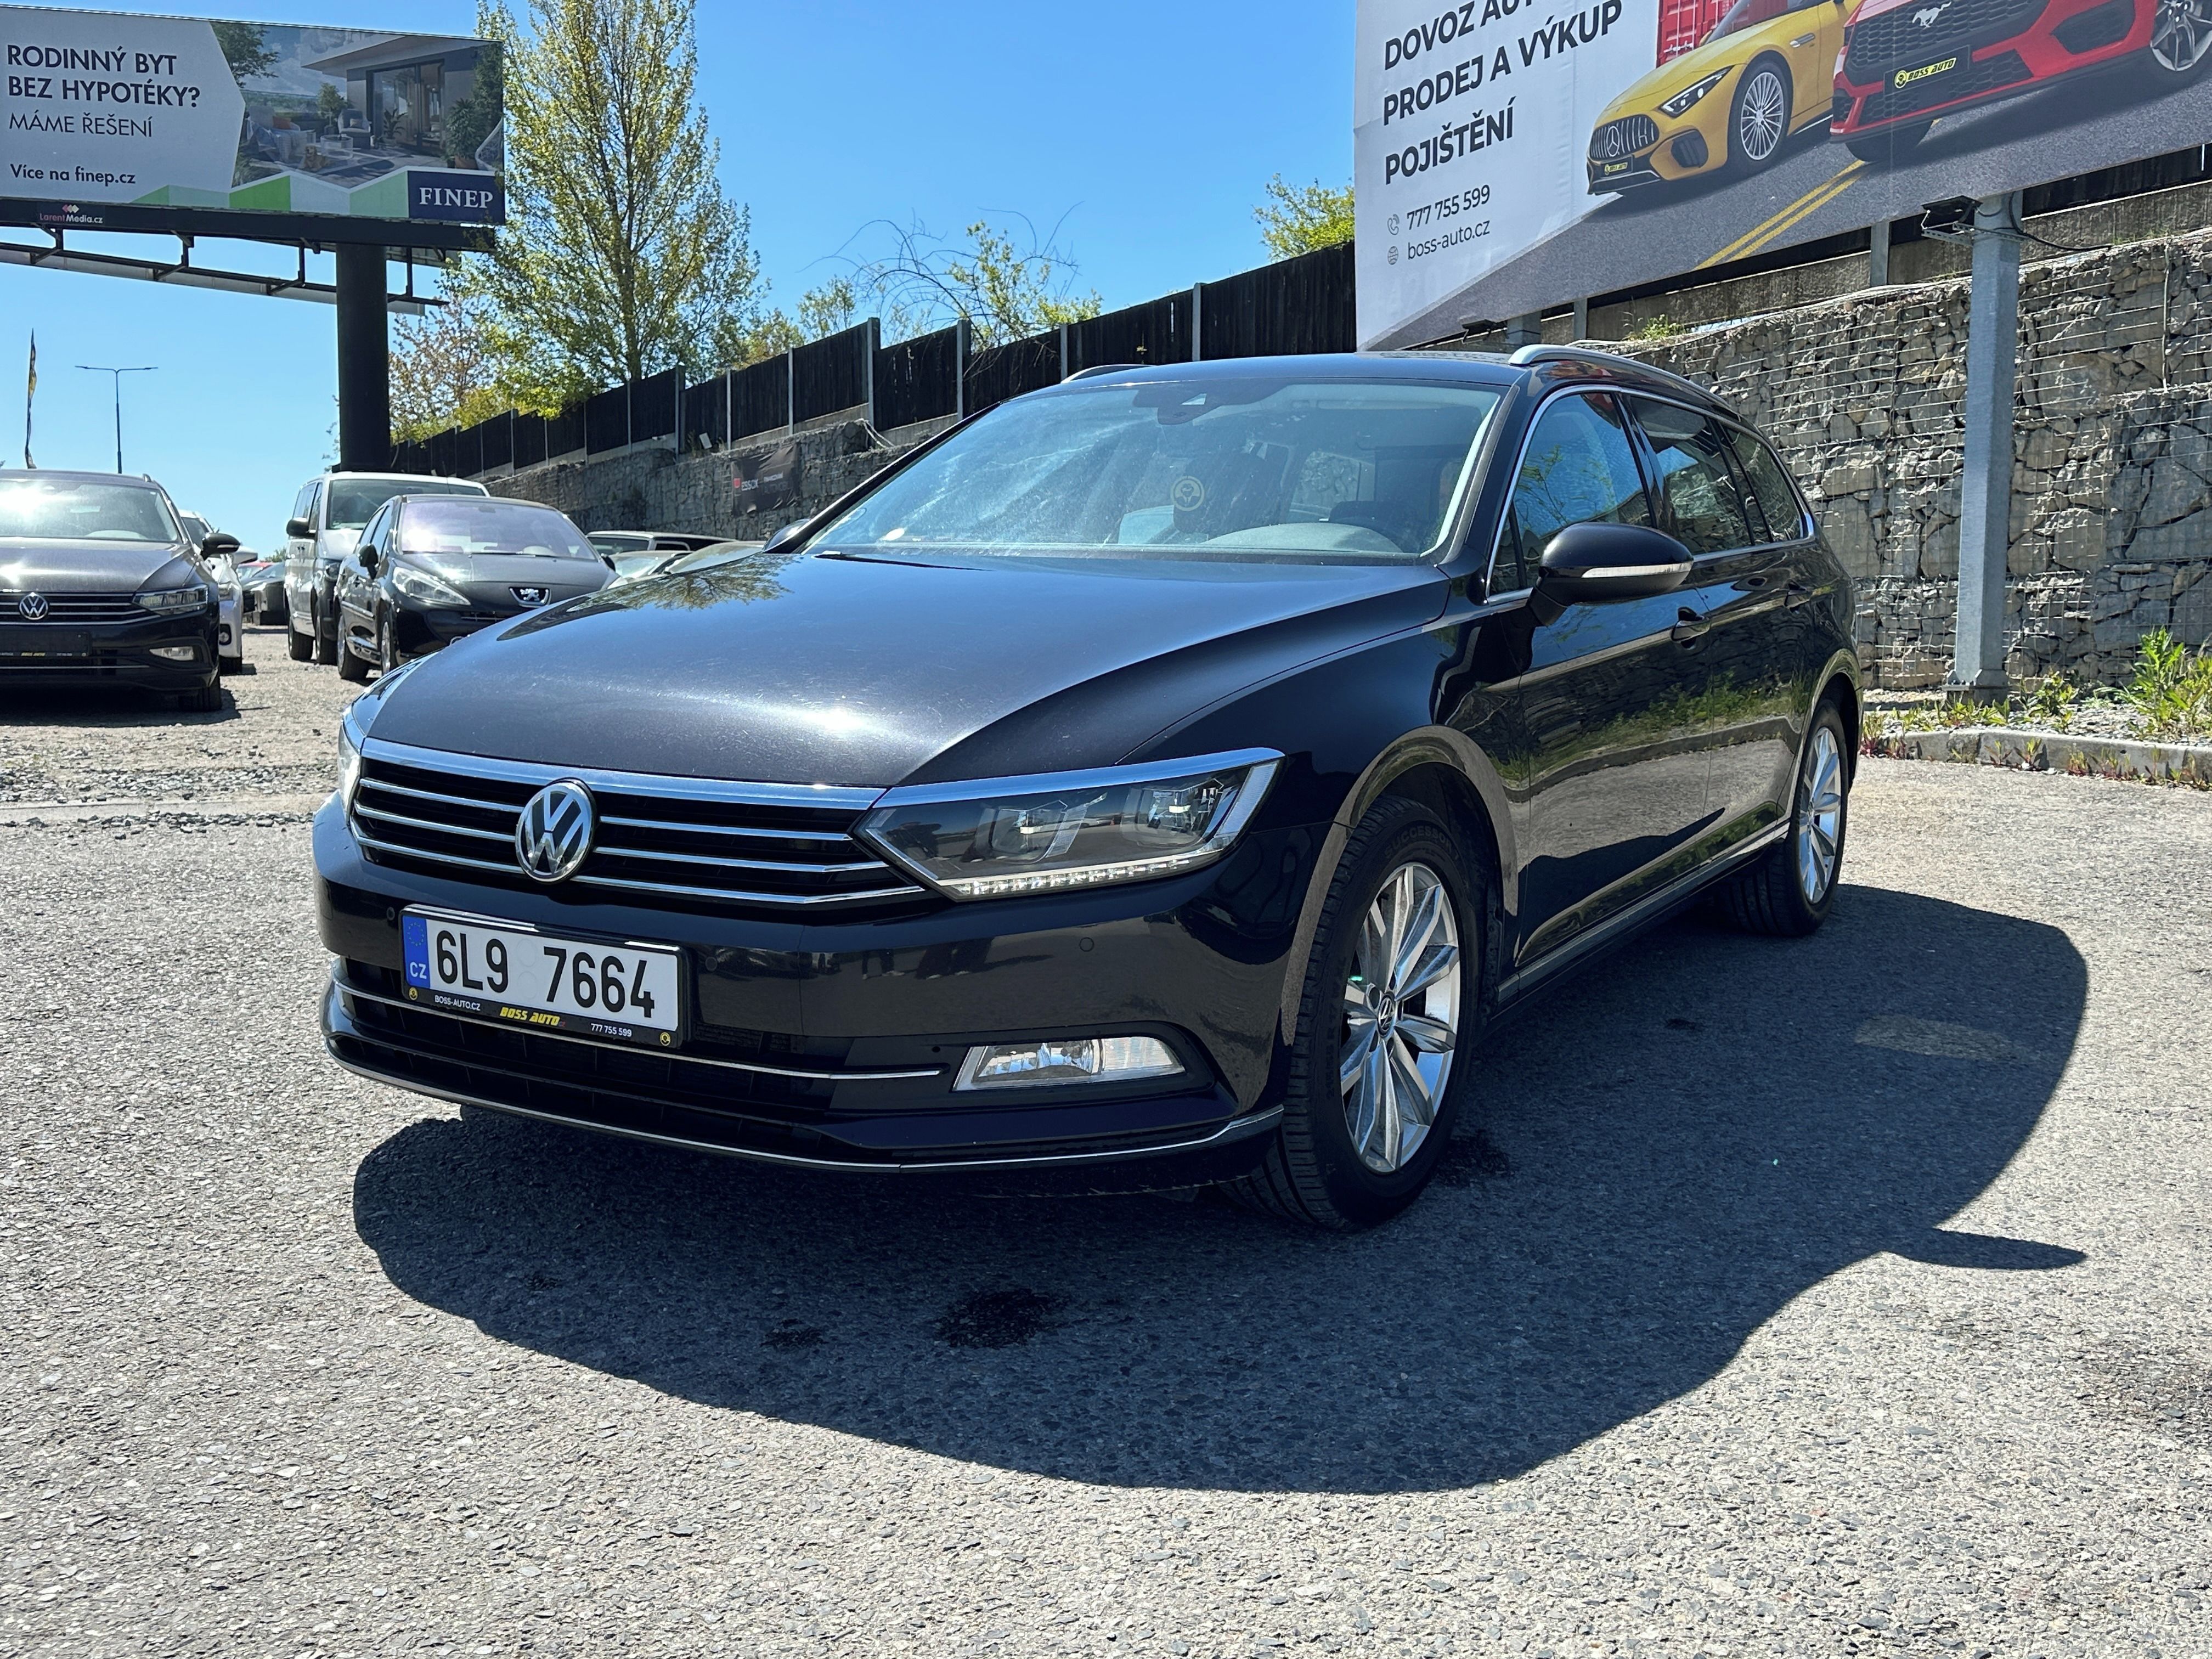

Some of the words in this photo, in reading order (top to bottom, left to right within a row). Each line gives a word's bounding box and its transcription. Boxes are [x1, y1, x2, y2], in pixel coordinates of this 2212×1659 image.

[1385, 1, 1475, 70] DOVOZ
[7, 44, 126, 72] RODINNÝ
[135, 53, 177, 75] BYT
[1384, 55, 1483, 126] PRODEJ
[1489, 46, 1511, 82] A
[1517, 0, 1622, 67] VÝKUP
[1908, 67, 1929, 80] BOSS
[1931, 59, 1954, 74] AUTO
[8, 76, 52, 99] BEZ
[62, 79, 200, 108] HYPOTÉKY?
[9, 110, 75, 133] MÁME
[82, 112, 153, 137] ŘEŠENÍ
[1385, 95, 1516, 185] POJIŠTĚNÍ
[10, 164, 44, 180] Více
[49, 168, 70, 181] na
[75, 166, 136, 187] finep.cz
[419, 187, 493, 210] FINEP
[1407, 205, 1431, 230] 777
[1435, 195, 1459, 221] 755
[1463, 184, 1490, 211] 599
[1408, 220, 1491, 260] boss-auto.cz
[410, 962, 427, 979] CZ
[436, 930, 509, 994] 6L9
[544, 946, 656, 1019] 7664
[499, 1007, 528, 1020] BOSS
[529, 1012, 560, 1026] AUTO
[590, 1023, 603, 1032] 777
[603, 1025, 617, 1035] 755
[618, 1027, 632, 1037] 599
